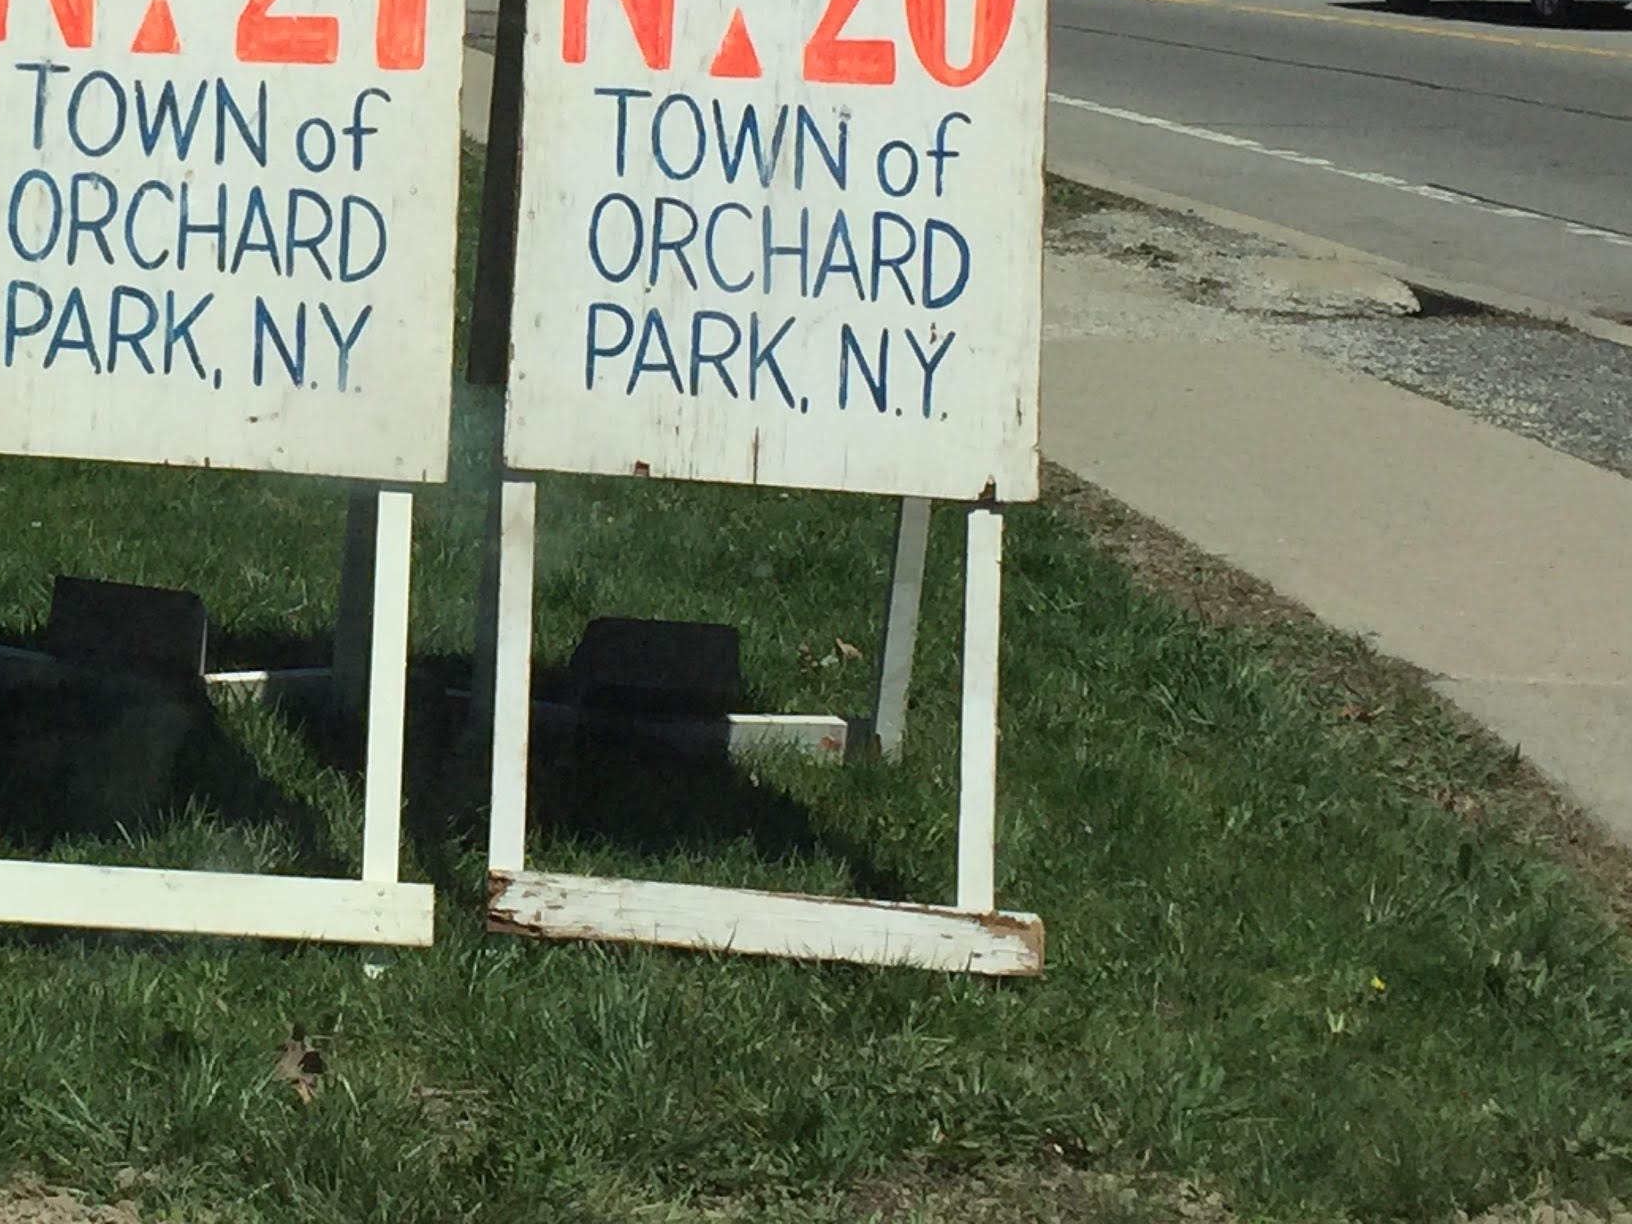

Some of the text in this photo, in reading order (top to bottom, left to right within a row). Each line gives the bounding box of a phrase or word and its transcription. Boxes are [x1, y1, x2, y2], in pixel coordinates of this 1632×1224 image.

[17, 62, 391, 174] TOWN of
[597, 87, 971, 198] TOWN of
[7, 169, 386, 284] ORCHARD
[588, 190, 972, 311] ORCHARD
